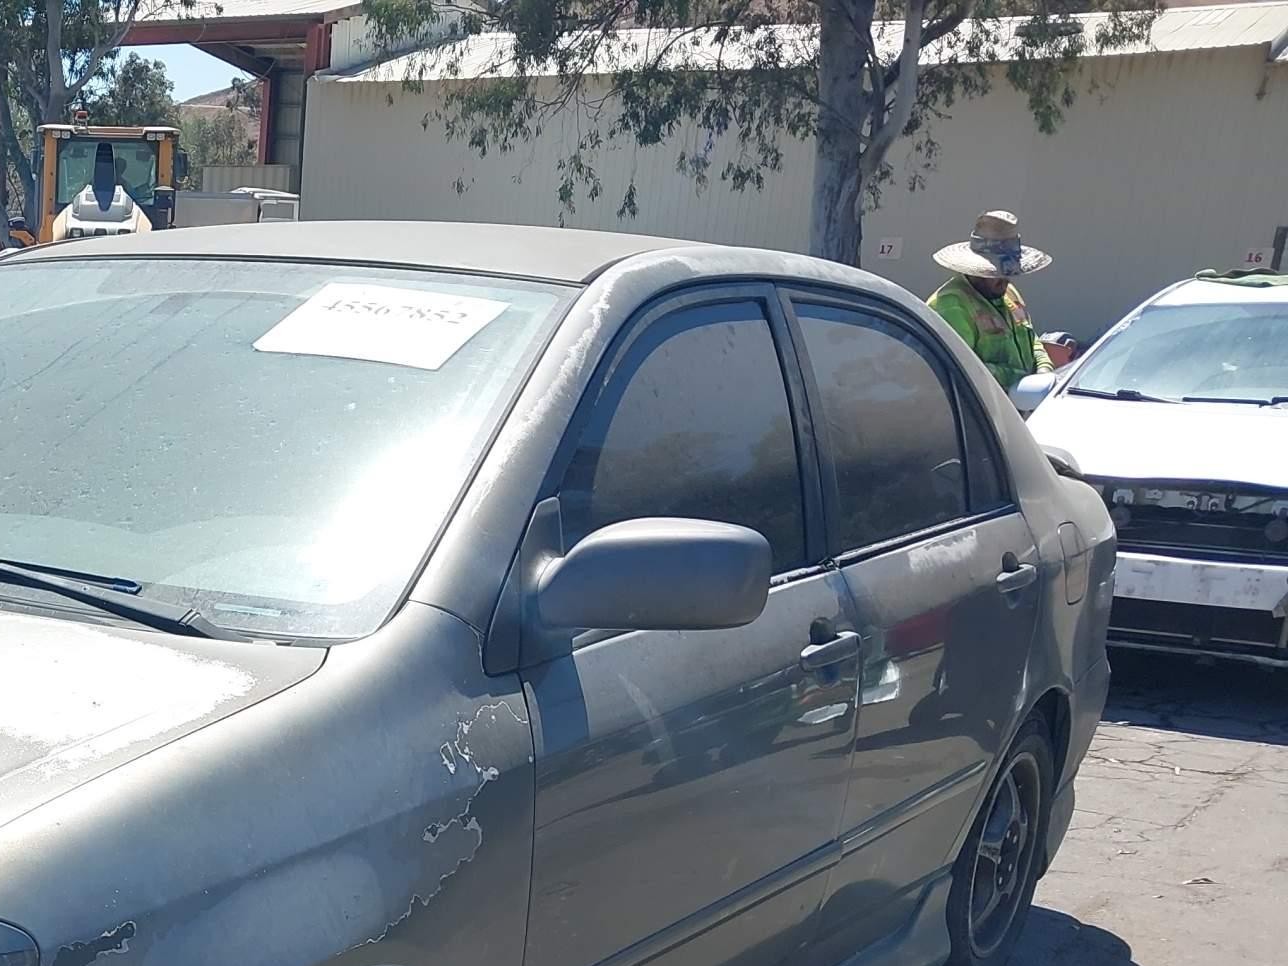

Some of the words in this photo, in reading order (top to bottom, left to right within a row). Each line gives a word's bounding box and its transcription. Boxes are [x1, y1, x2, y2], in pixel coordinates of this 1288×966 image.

[880, 244, 894, 255] 17
[1245, 252, 1263, 263] 16
[322, 299, 469, 325] 45567852
